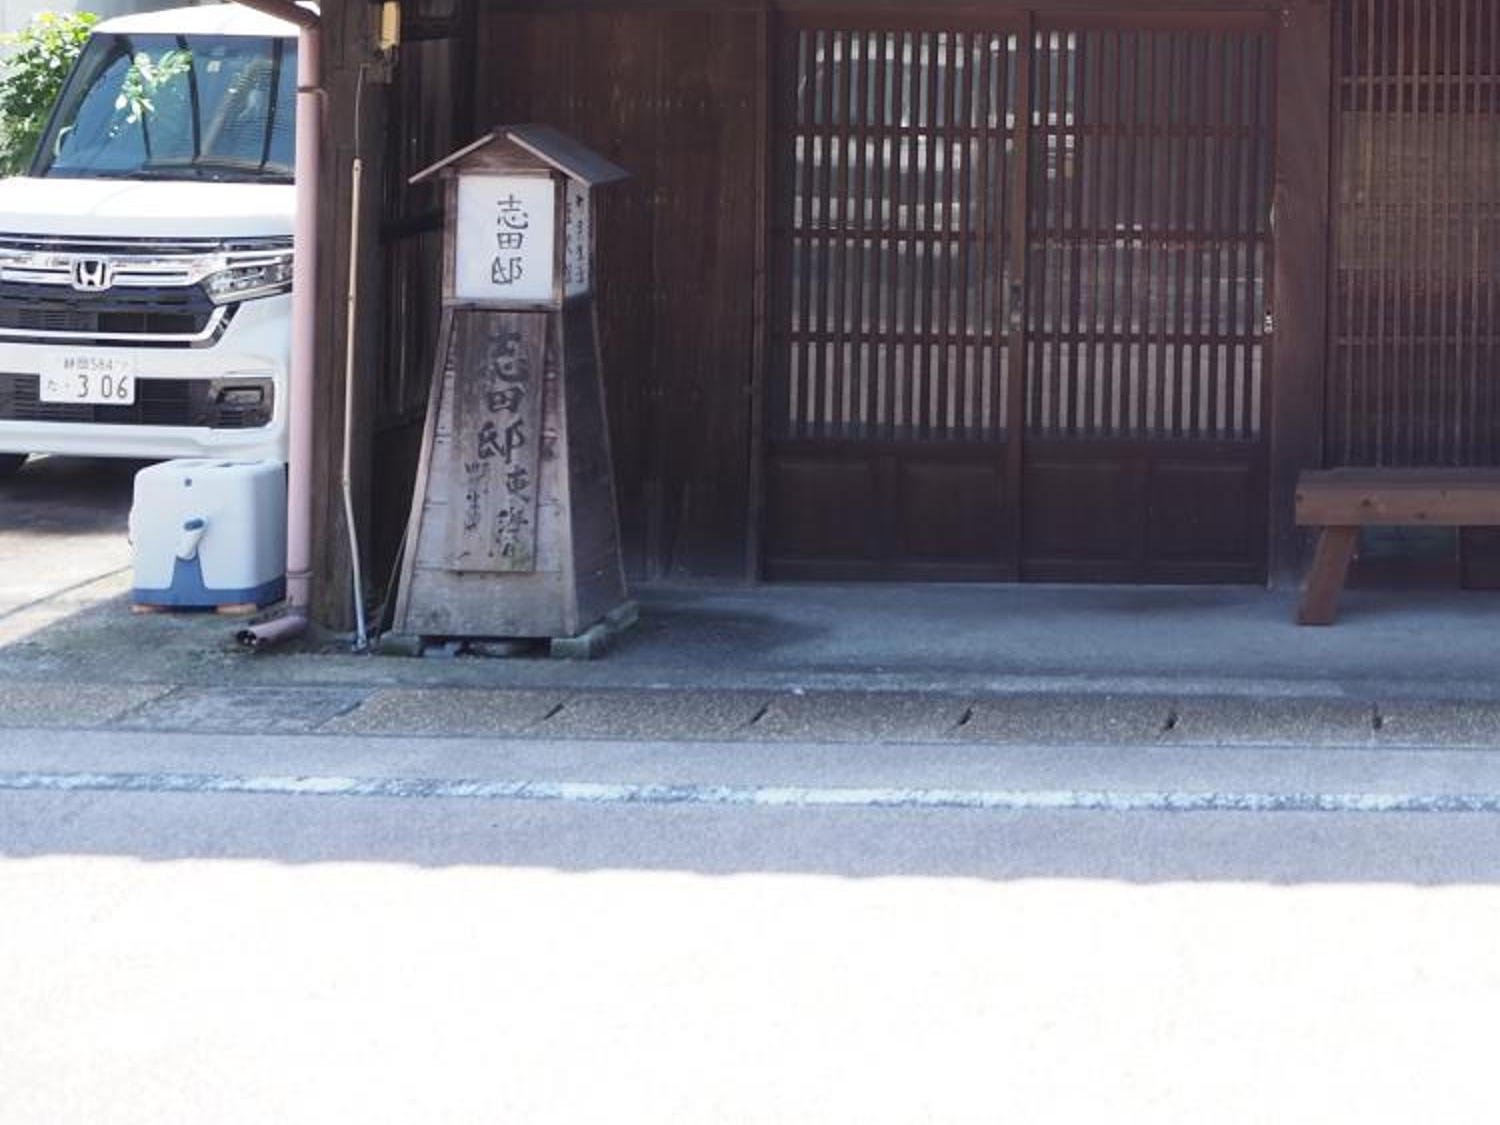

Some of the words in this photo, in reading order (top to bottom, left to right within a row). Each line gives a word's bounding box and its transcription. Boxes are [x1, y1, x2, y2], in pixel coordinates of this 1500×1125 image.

[491, 194, 529, 284] 志田邸
[478, 330, 527, 465] 志田邸
